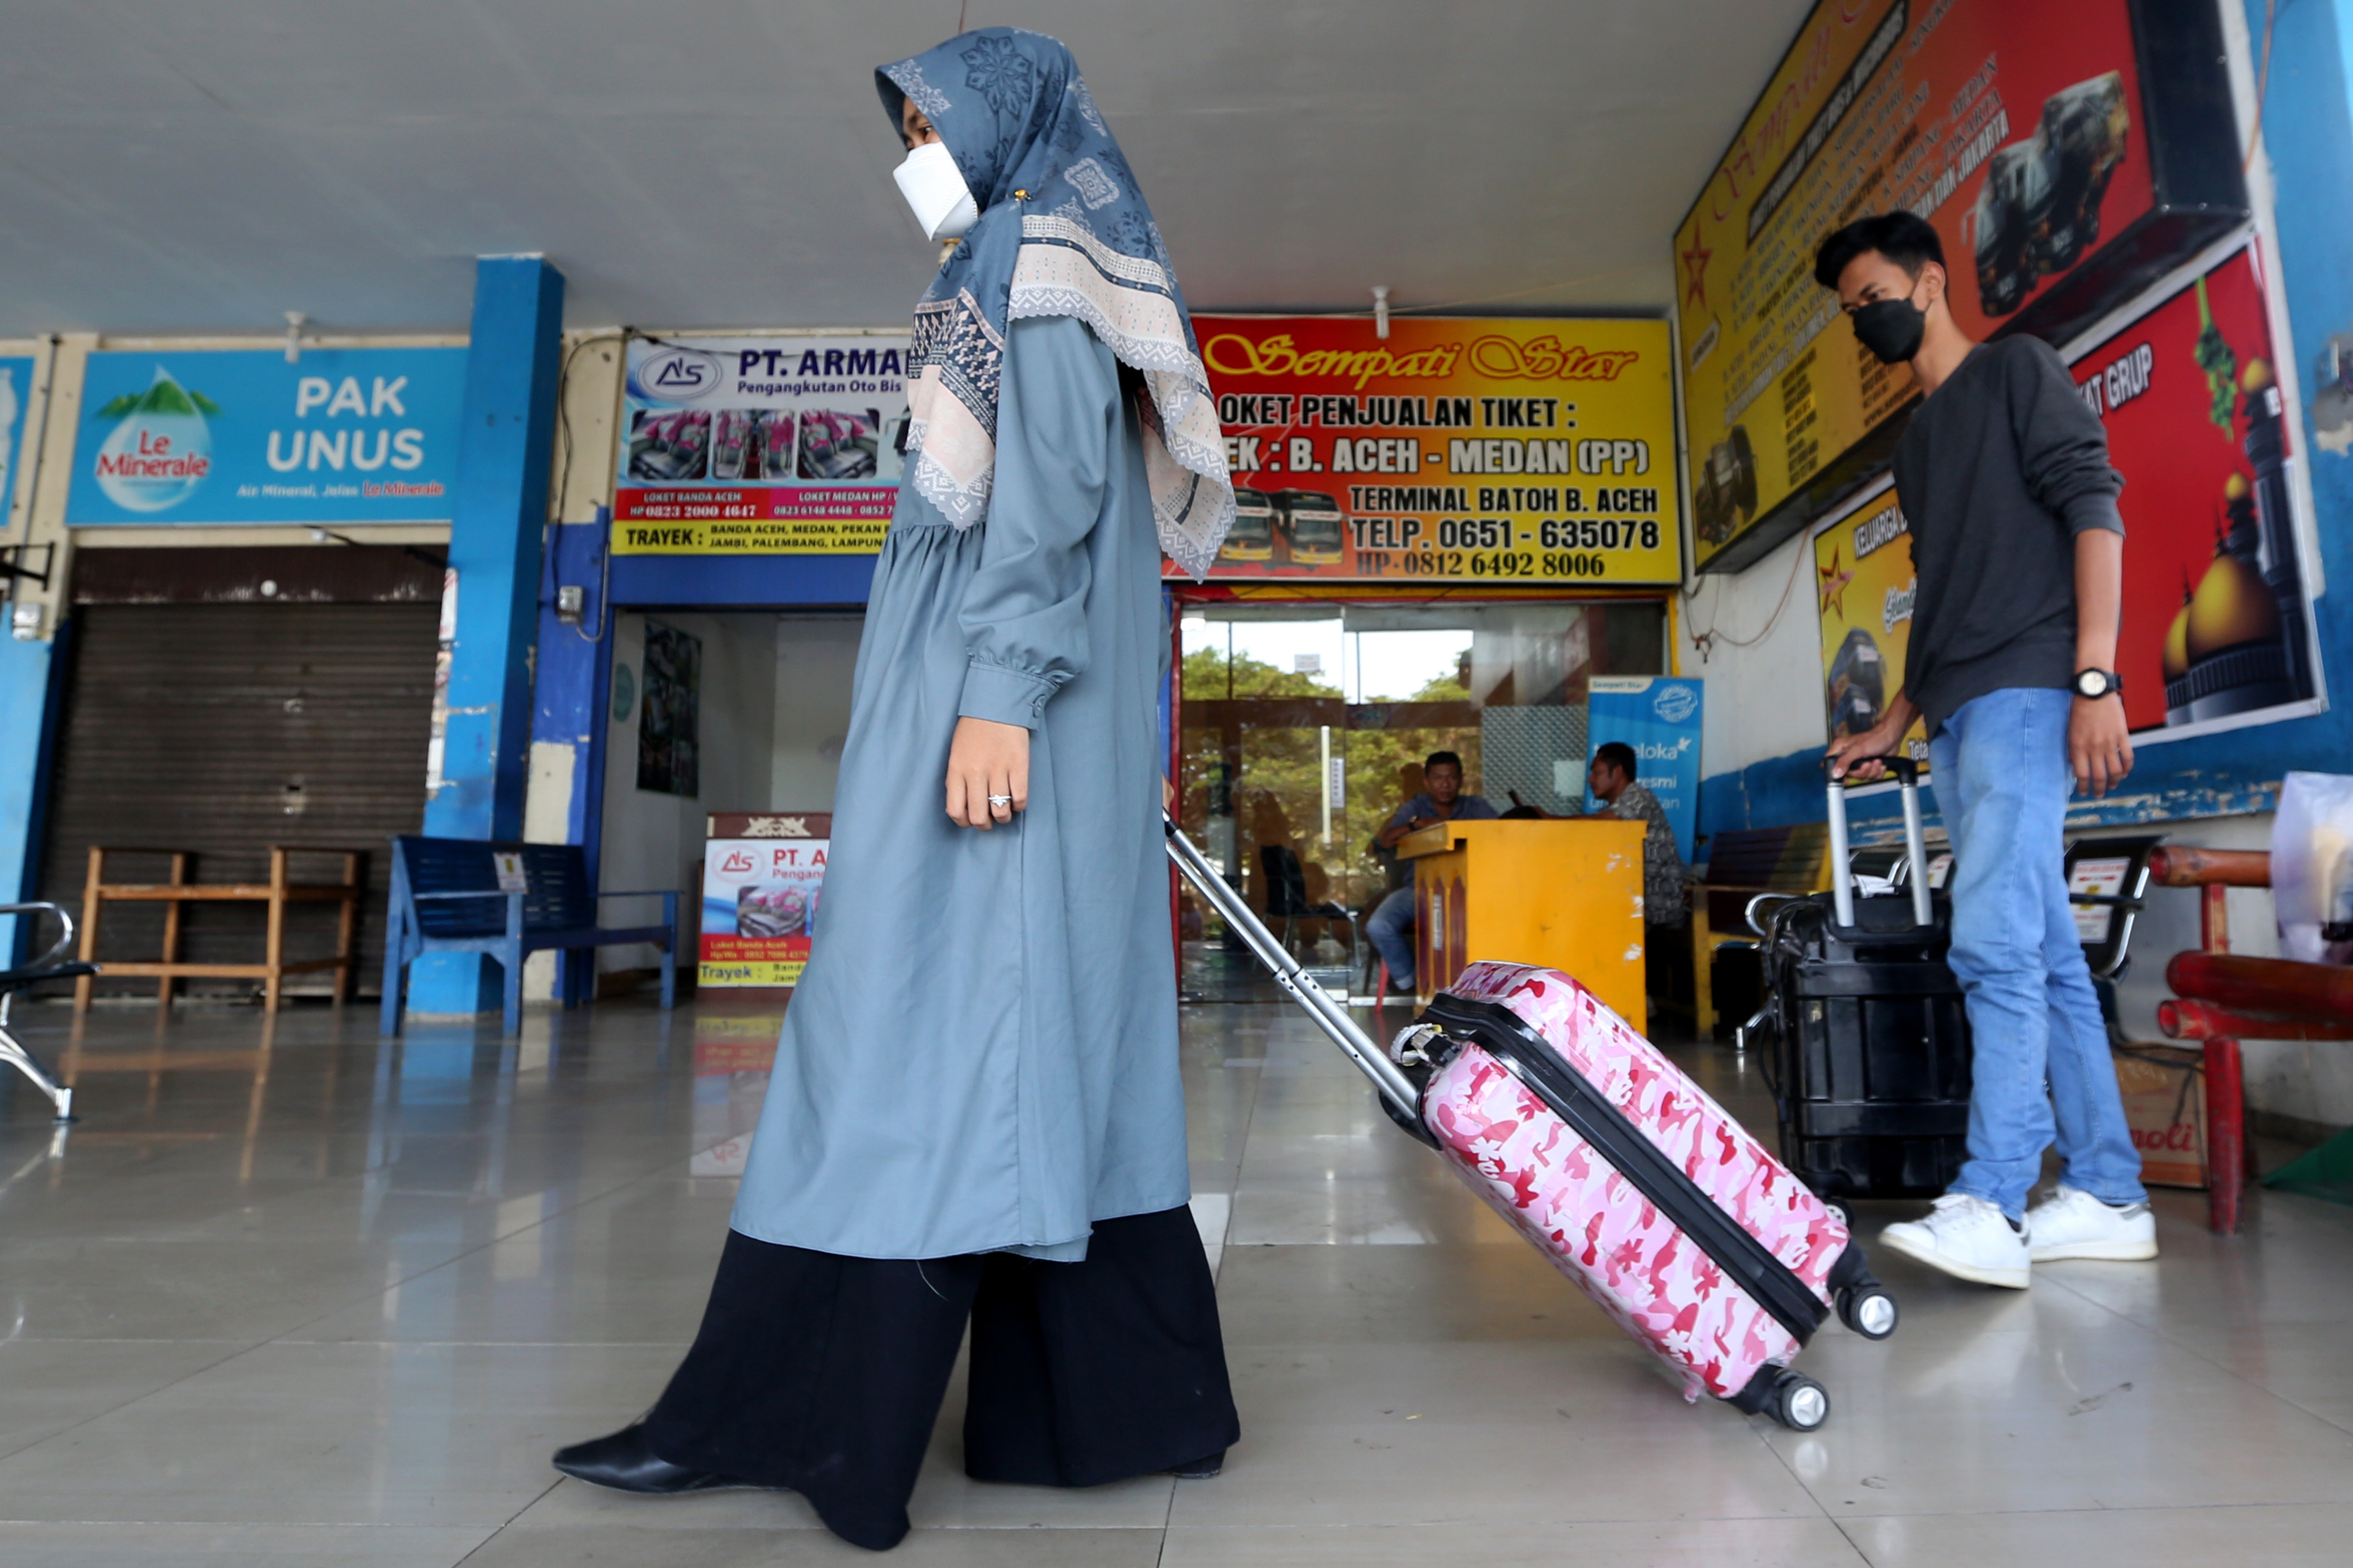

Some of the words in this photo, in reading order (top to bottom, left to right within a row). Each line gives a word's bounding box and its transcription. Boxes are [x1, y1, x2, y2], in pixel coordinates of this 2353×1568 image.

[1941, 80, 2002, 168] JAKARTA
[1957, 105, 2009, 186] JAKARTA
[738, 349, 788, 376] PT.
[1204, 333, 1462, 391] Sempati
[1468, 334, 1639, 381] Star
[2106, 342, 2154, 409] GRUP
[295, 376, 409, 418] PAK
[737, 379, 845, 398] Pengangkutan
[849, 380, 877, 393] Oto
[880, 379, 902, 393] Bis
[1218, 393, 1295, 427] OKET
[1299, 395, 1472, 428] PENJUALAN
[1482, 396, 1558, 428] TIKET
[138, 429, 171, 456] Le
[266, 429, 425, 472] UNUS
[1222, 436, 1262, 473] EK
[1289, 436, 1324, 473] B.
[1331, 437, 1420, 473] ACEH
[1449, 439, 1571, 474] MEDAN
[1577, 439, 1649, 476] (PP)
[96, 452, 210, 478] Minerale
[774, 505, 798, 515] 0823
[859, 505, 885, 515] 0852
[798, 492, 831, 501] LOKET
[832, 492, 869, 501] MEDAN
[871, 492, 886, 501] HP
[1350, 486, 1472, 512] TERMINAL
[1478, 487, 1558, 513] BATOH
[1565, 488, 1591, 513] B.
[1597, 489, 1659, 513] ACEH
[645, 505, 681, 518] 0823
[684, 505, 720, 517] 2000
[626, 528, 694, 546] TRAYEK
[711, 524, 752, 534] BANDA
[755, 524, 788, 535] ACEH,
[791, 524, 838, 535] MEDAN,
[841, 524, 881, 534] PEKAN
[1352, 519, 1431, 549] TELP.
[1438, 519, 1513, 549] 0651
[1538, 519, 1661, 549] 635078
[1853, 505, 1900, 560] KELUARGA
[709, 538, 748, 548] JAMBI,
[752, 538, 828, 549] PALEMBANG,
[831, 538, 885, 547] LAMPUN
[1404, 552, 1464, 575] 0812
[1471, 552, 1535, 576] 6492
[1542, 552, 1605, 576] 8006
[1882, 579, 1917, 632] Selama
[1908, 739, 1929, 761] Teta
[773, 849, 803, 866] PT.
[700, 965, 752, 982] Trayek
